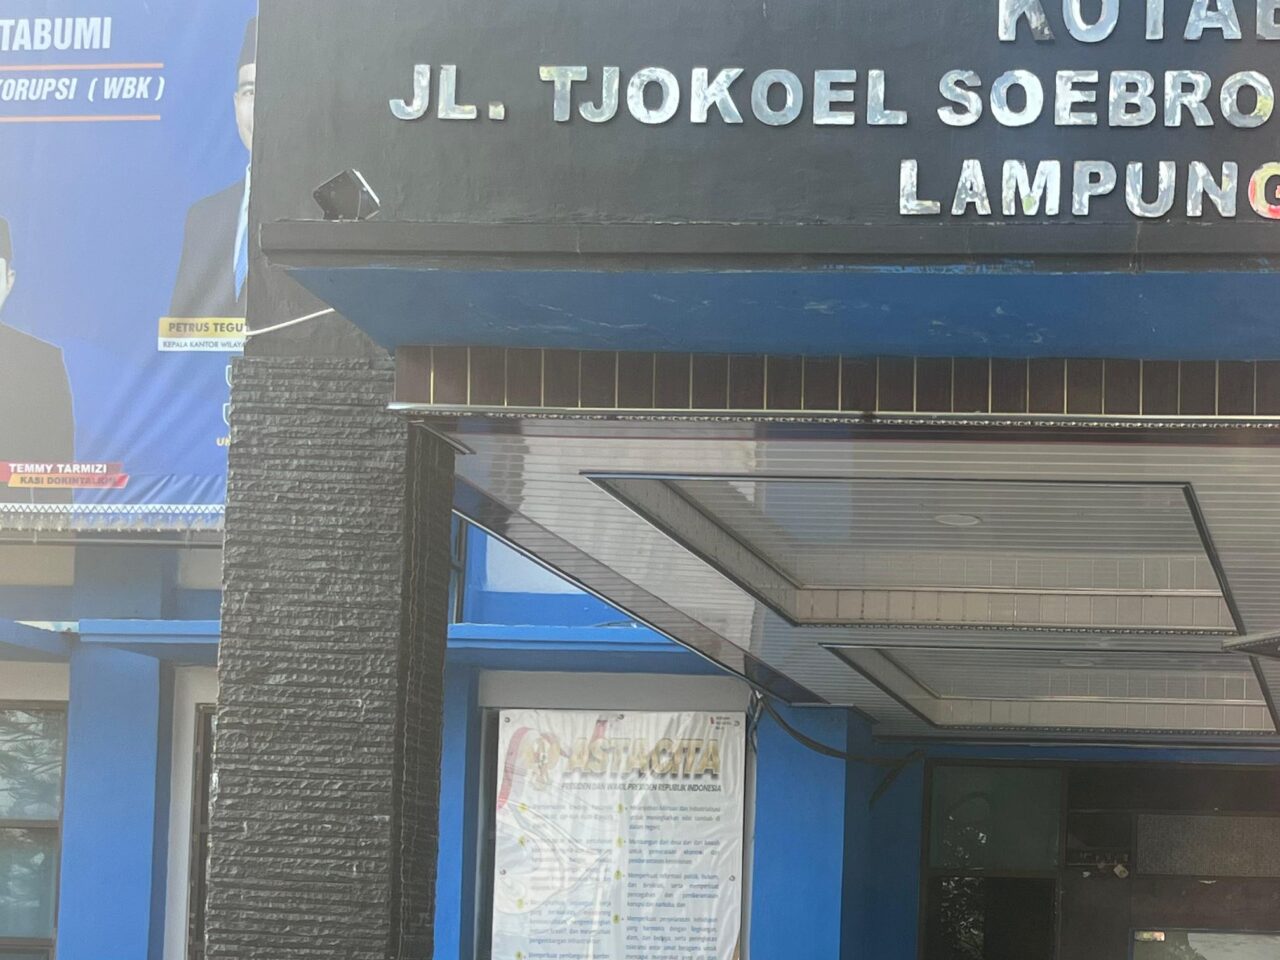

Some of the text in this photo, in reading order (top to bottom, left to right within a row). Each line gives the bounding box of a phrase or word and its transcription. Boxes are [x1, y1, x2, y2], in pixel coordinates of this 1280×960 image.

[104, 77, 152, 100] WBK
[389, 64, 505, 121] JL.
[539, 66, 907, 126] TJOKOEL
[168, 322, 210, 333] PETRUS
[9, 463, 107, 474] TEMMY TARMIZI
[20, 476, 45, 485] KASI
